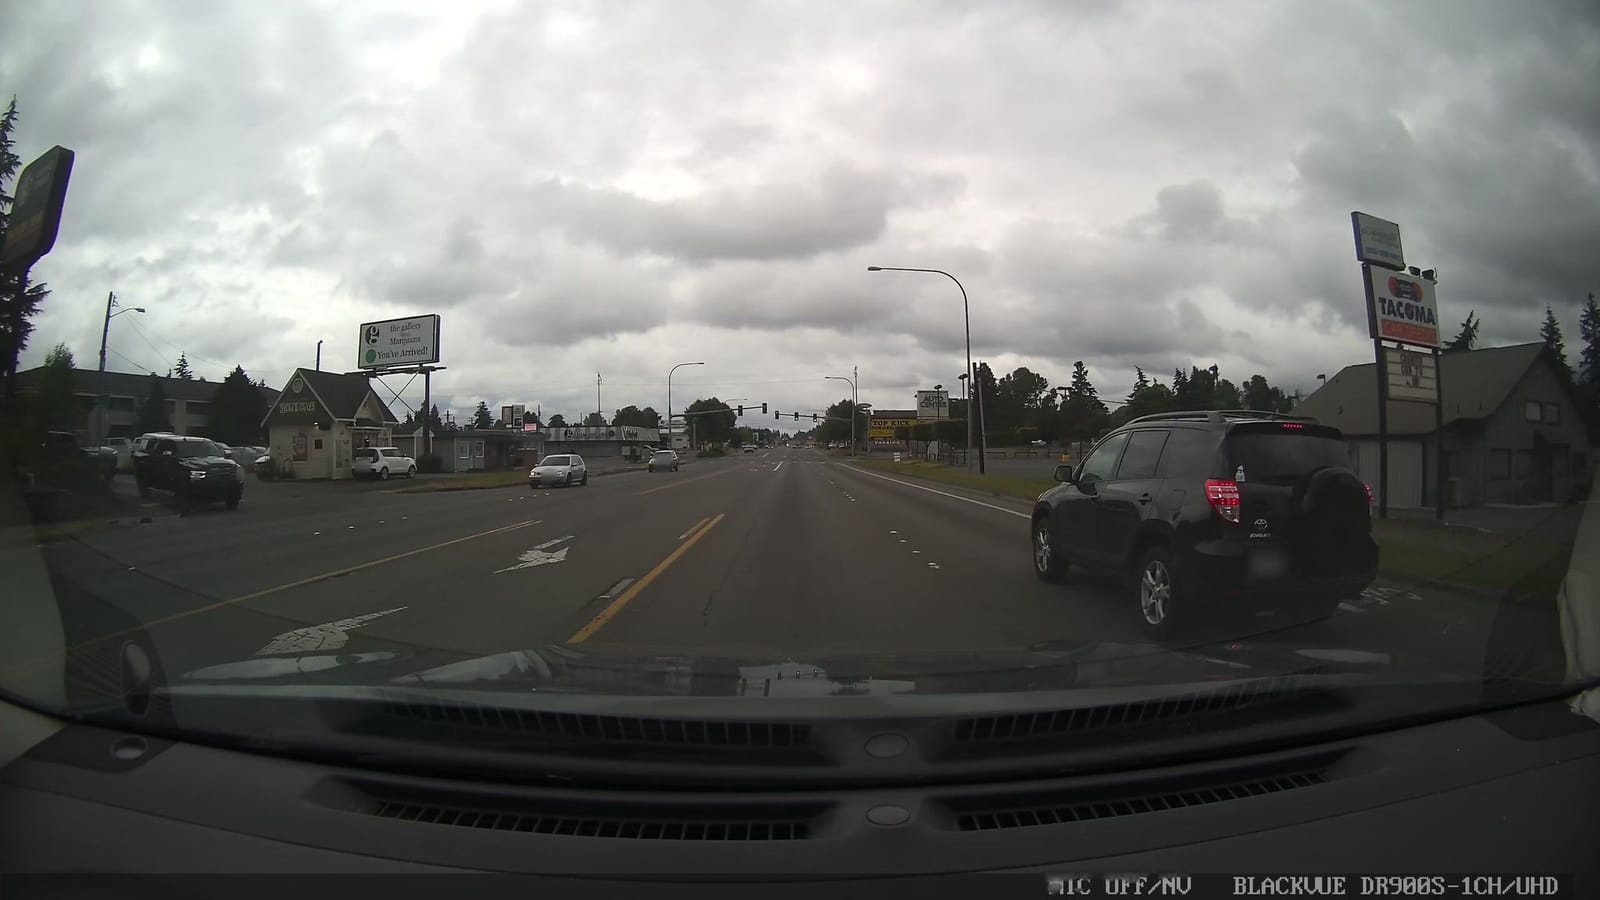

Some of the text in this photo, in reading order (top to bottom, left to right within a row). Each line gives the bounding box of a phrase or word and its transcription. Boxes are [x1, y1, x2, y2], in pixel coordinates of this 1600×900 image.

[1378, 297, 1436, 325] TACOMA
[389, 336, 421, 346] Marijuana
[377, 346, 428, 359] You've Arrived!
